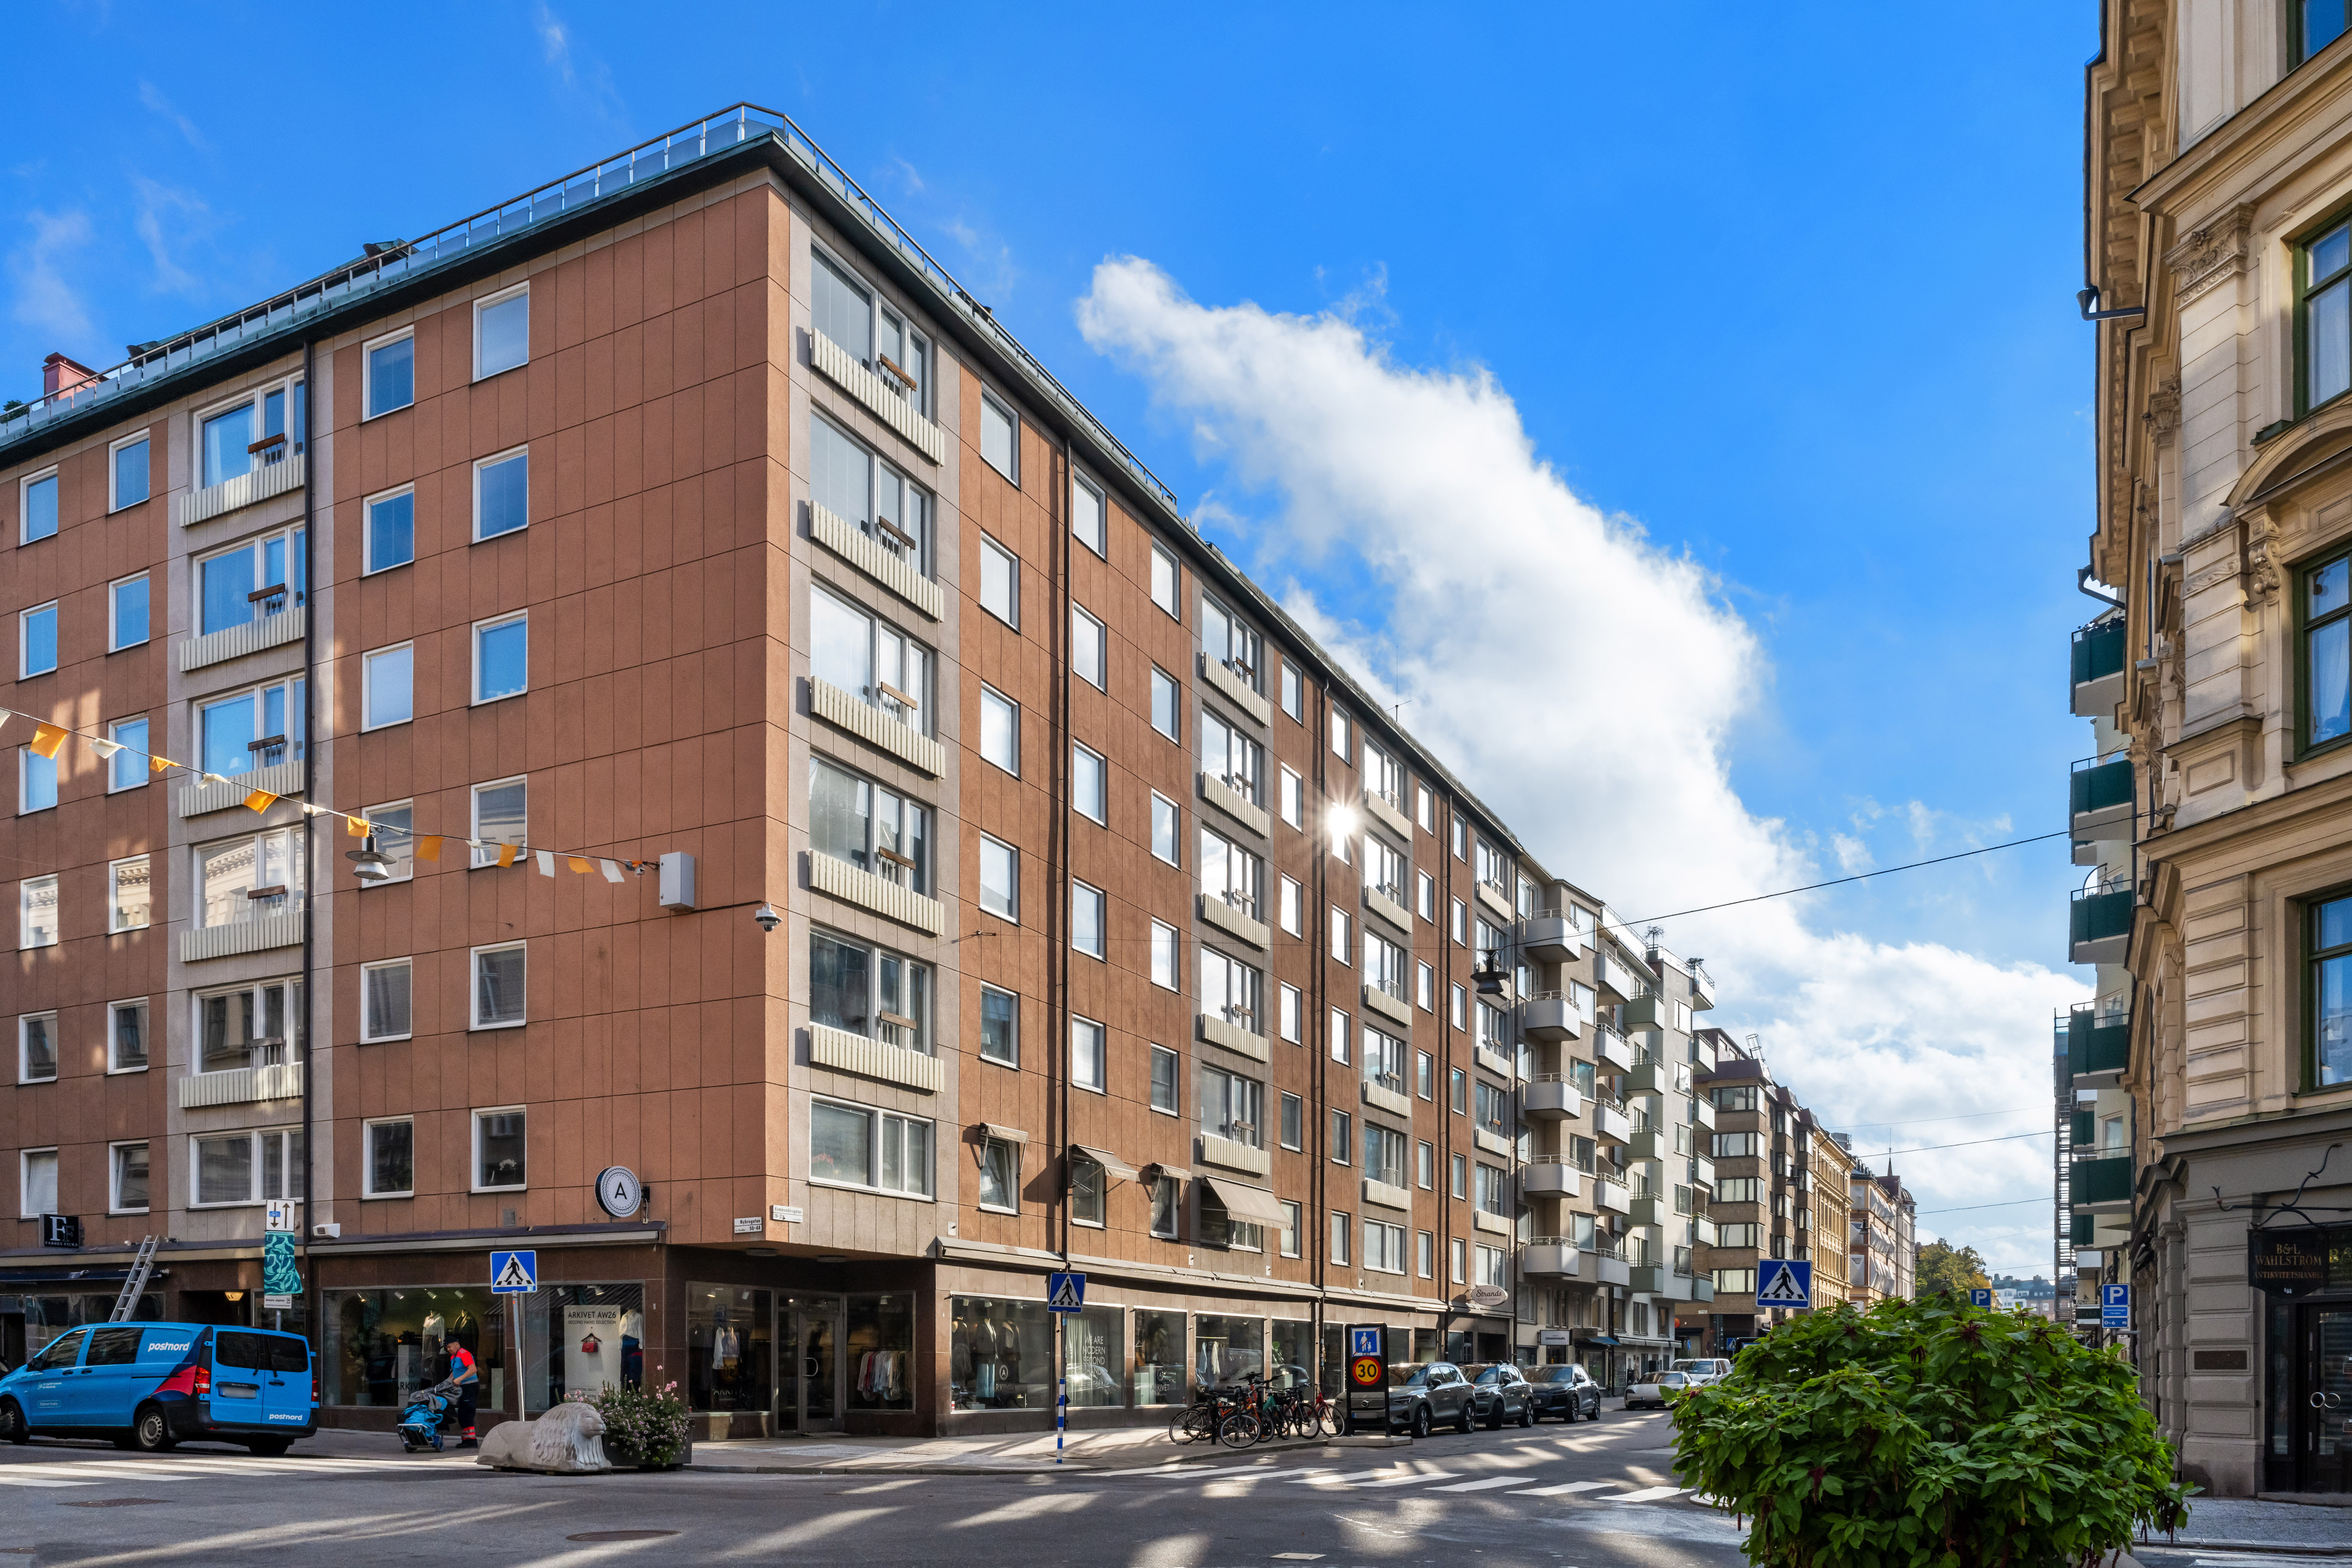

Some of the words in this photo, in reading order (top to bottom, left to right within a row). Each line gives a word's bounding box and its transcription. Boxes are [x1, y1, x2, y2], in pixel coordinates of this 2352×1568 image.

[614, 1182, 628, 1200] A
[2277, 1244, 2300, 1254] B&L
[2255, 1254, 2322, 1266] WAHLSTRÖM
[1976, 1290, 1987, 1305] P
[2110, 1287, 2124, 1304] P
[148, 1342, 191, 1352] postnord
[1082, 1346, 1105, 1354] MODERN
[1083, 1356, 1105, 1365] SECOND
[1087, 1366, 1103, 1375] HAND
[1358, 1364, 1377, 1378] 30
